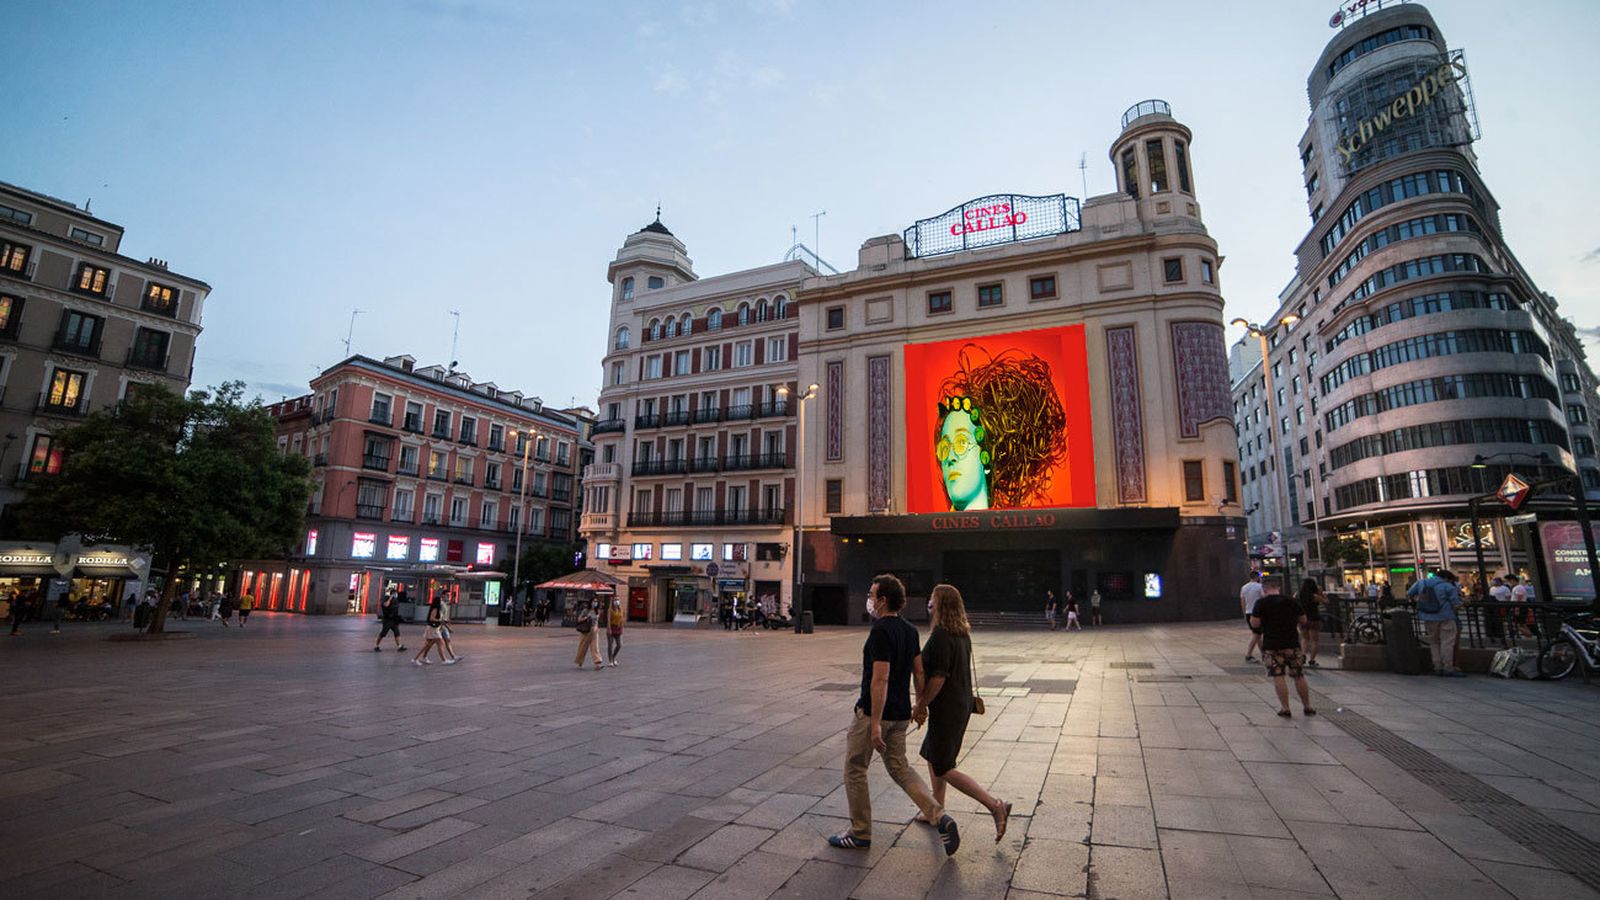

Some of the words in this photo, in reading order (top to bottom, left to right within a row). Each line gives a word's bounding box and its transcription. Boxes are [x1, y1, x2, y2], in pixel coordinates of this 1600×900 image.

[1335, 55, 1467, 164] Schweppes
[965, 203, 1011, 219] CINES
[950, 212, 1027, 236] CALLAO
[932, 516, 979, 529] CINES
[991, 514, 1055, 528] CALLAO
[78, 557, 128, 565] RODILLA
